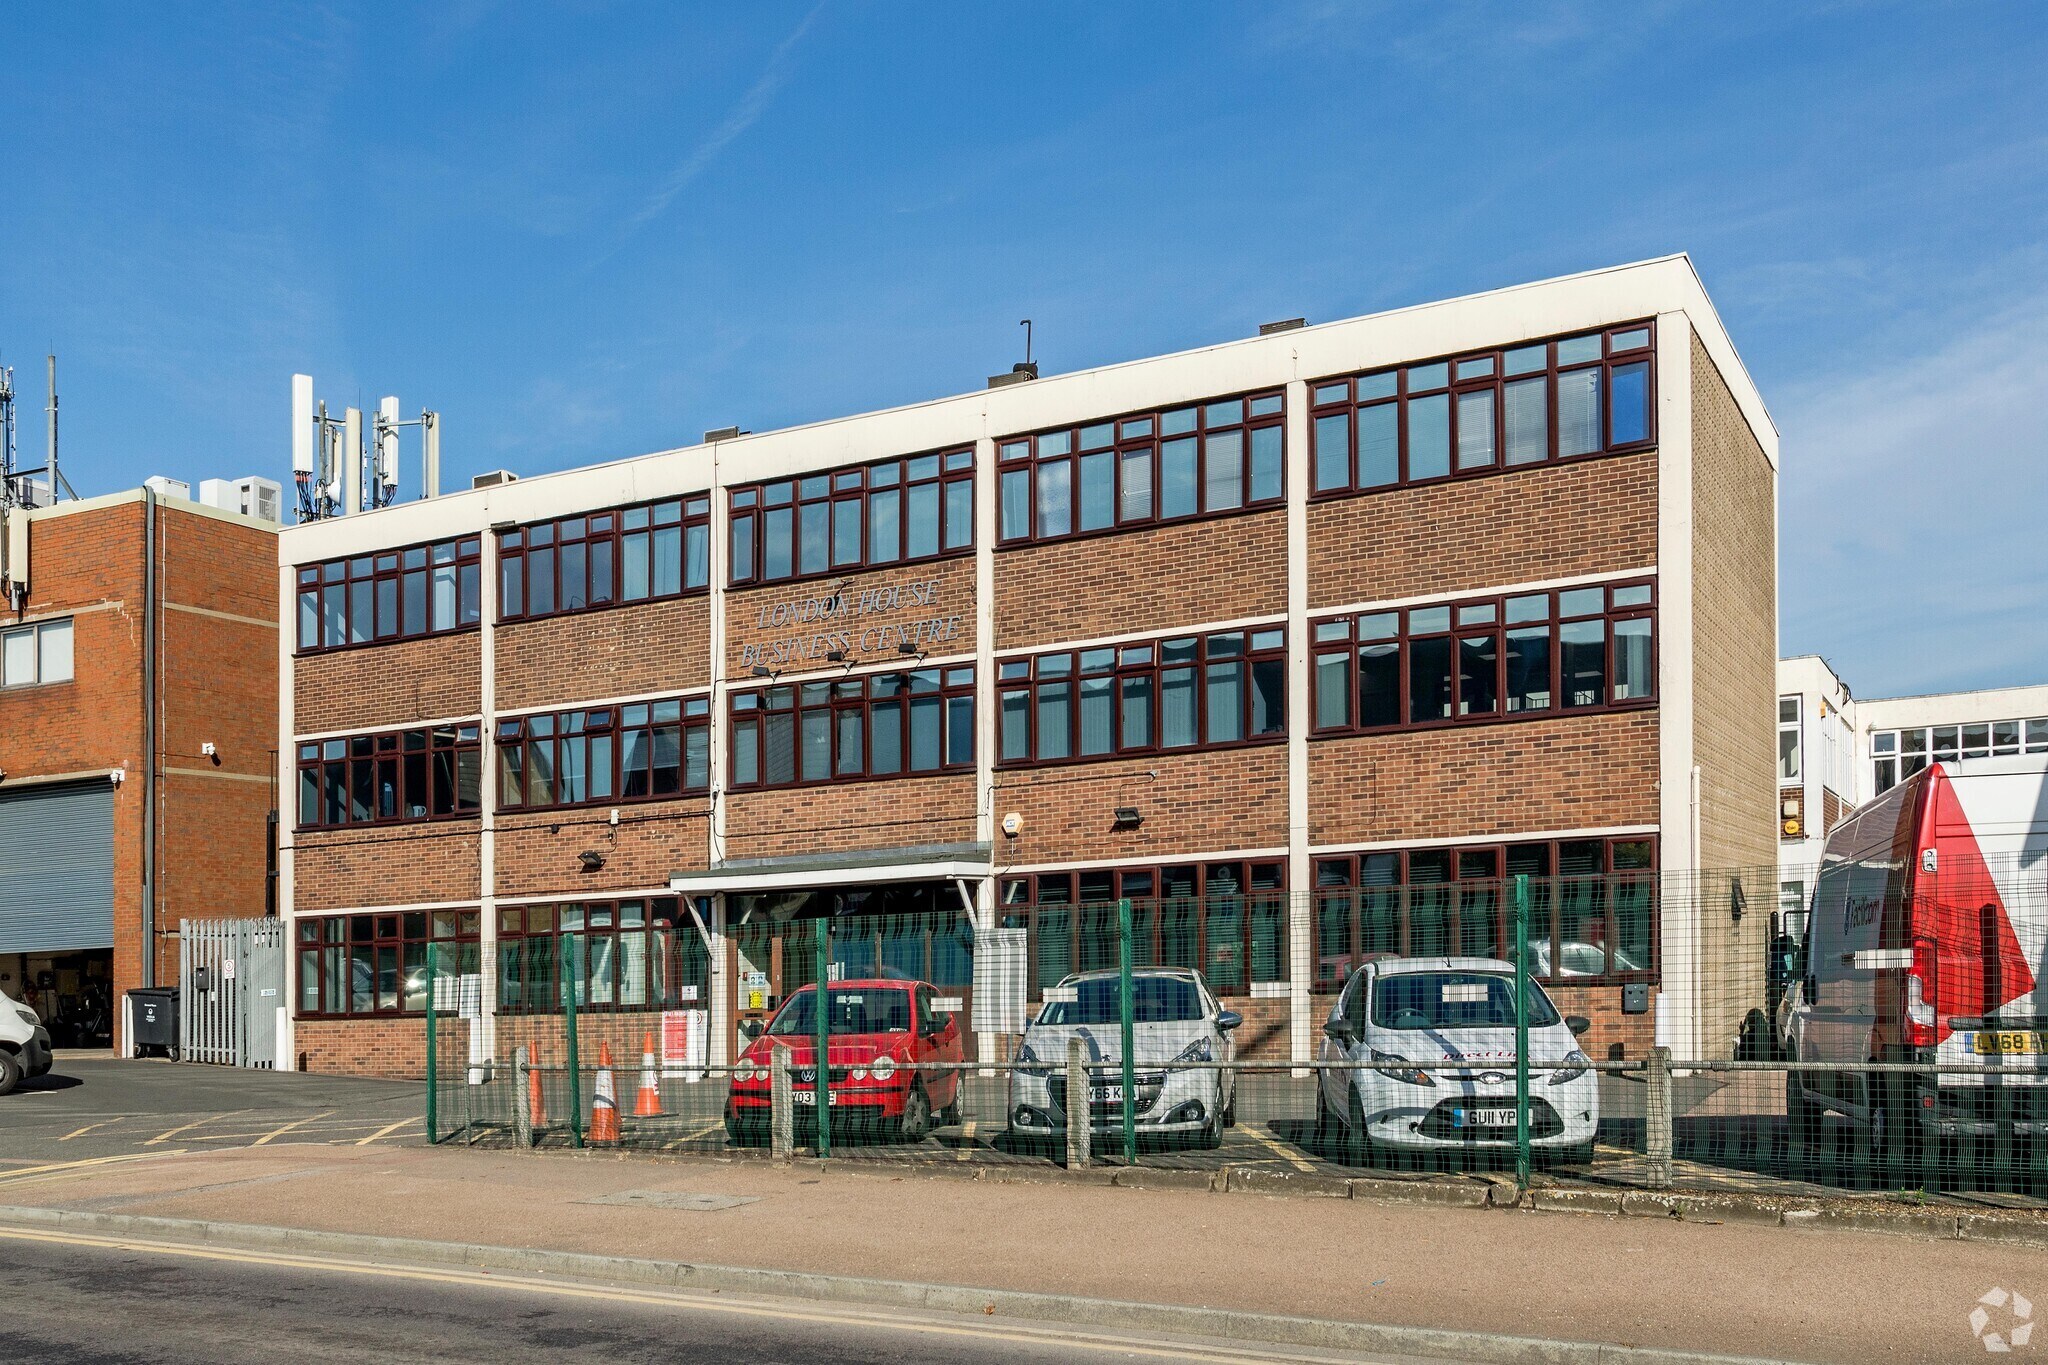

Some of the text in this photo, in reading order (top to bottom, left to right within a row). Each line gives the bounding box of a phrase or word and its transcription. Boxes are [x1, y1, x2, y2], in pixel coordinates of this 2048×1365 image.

[756, 579, 941, 629] LONDON HOUSE
[740, 615, 962, 668] BUSINESS CENTRE
[1977, 1034, 2024, 1050] LV68
[1443, 1051, 1491, 1060] Direct
[792, 1092, 811, 1103] Y03
[1089, 1087, 1110, 1100] Y66
[1469, 1111, 1516, 1125] GU11 YP
